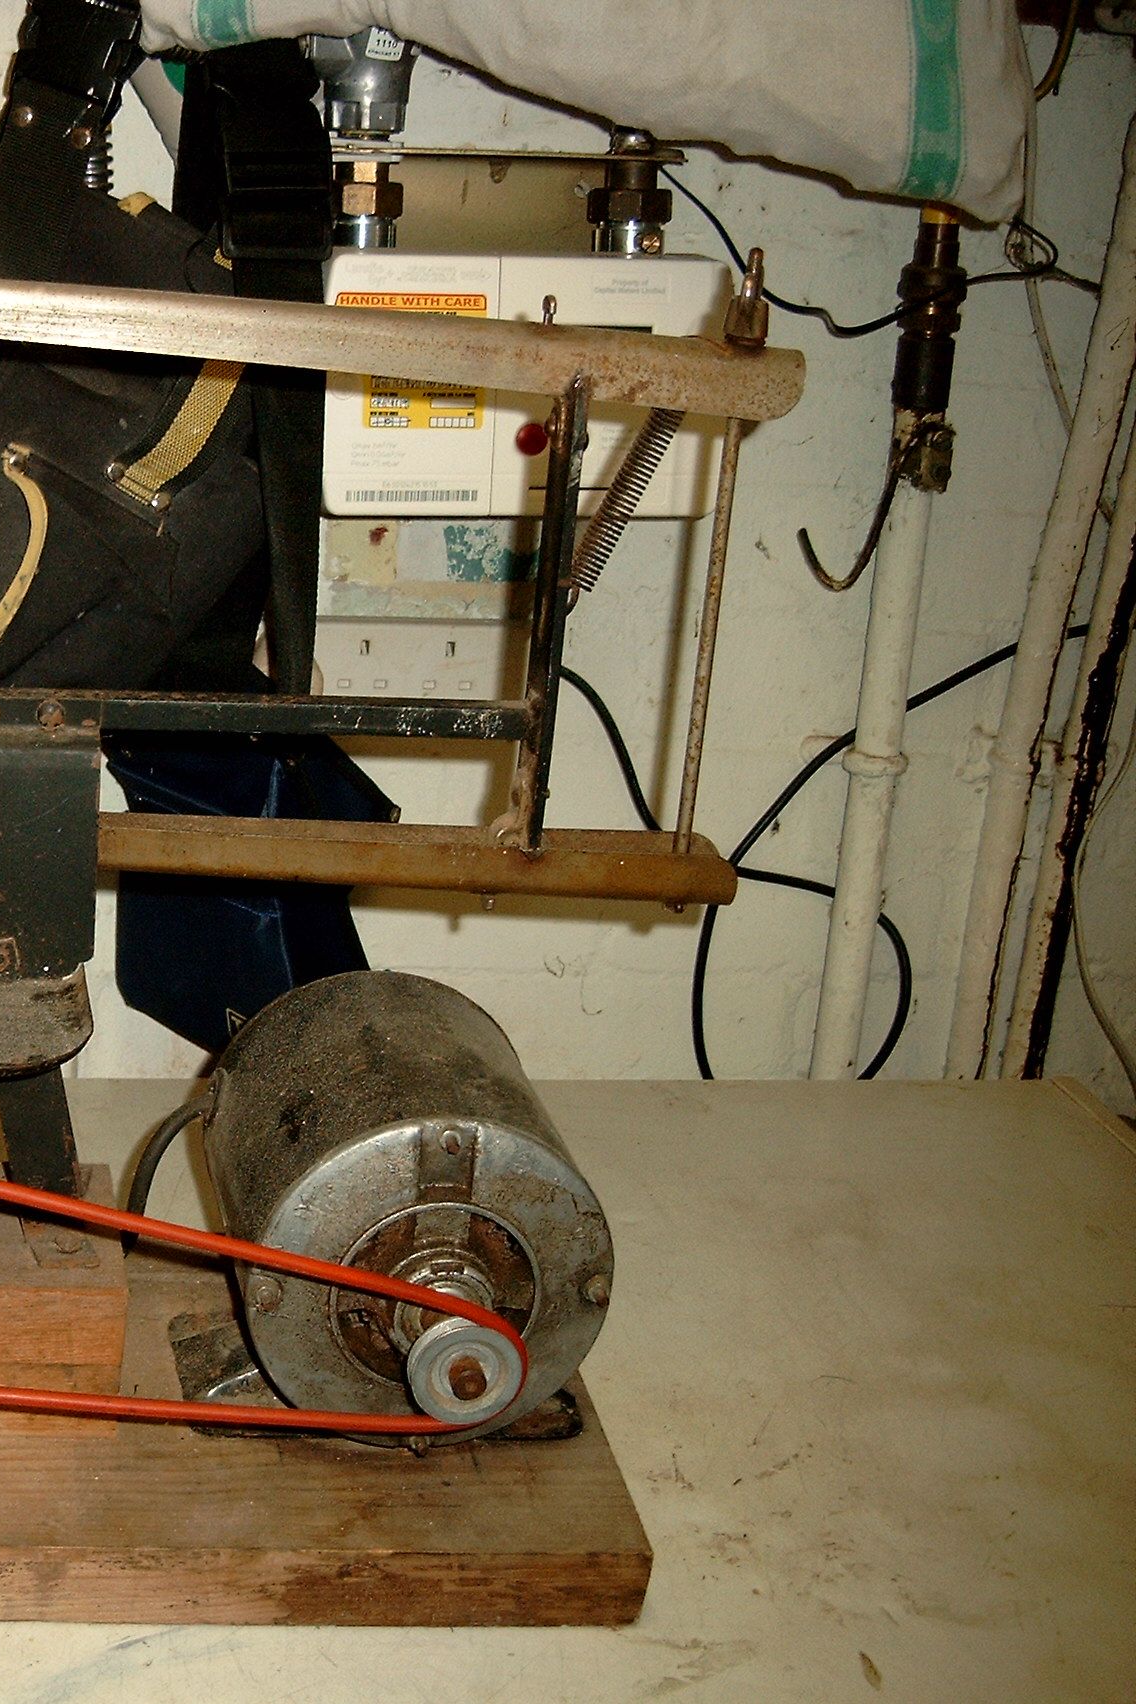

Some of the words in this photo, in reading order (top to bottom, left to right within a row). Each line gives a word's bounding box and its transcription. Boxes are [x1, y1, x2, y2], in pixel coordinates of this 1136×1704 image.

[339, 296, 396, 306] HANDLE
[402, 296, 439, 307] WITH
[444, 297, 481, 307] CARE
